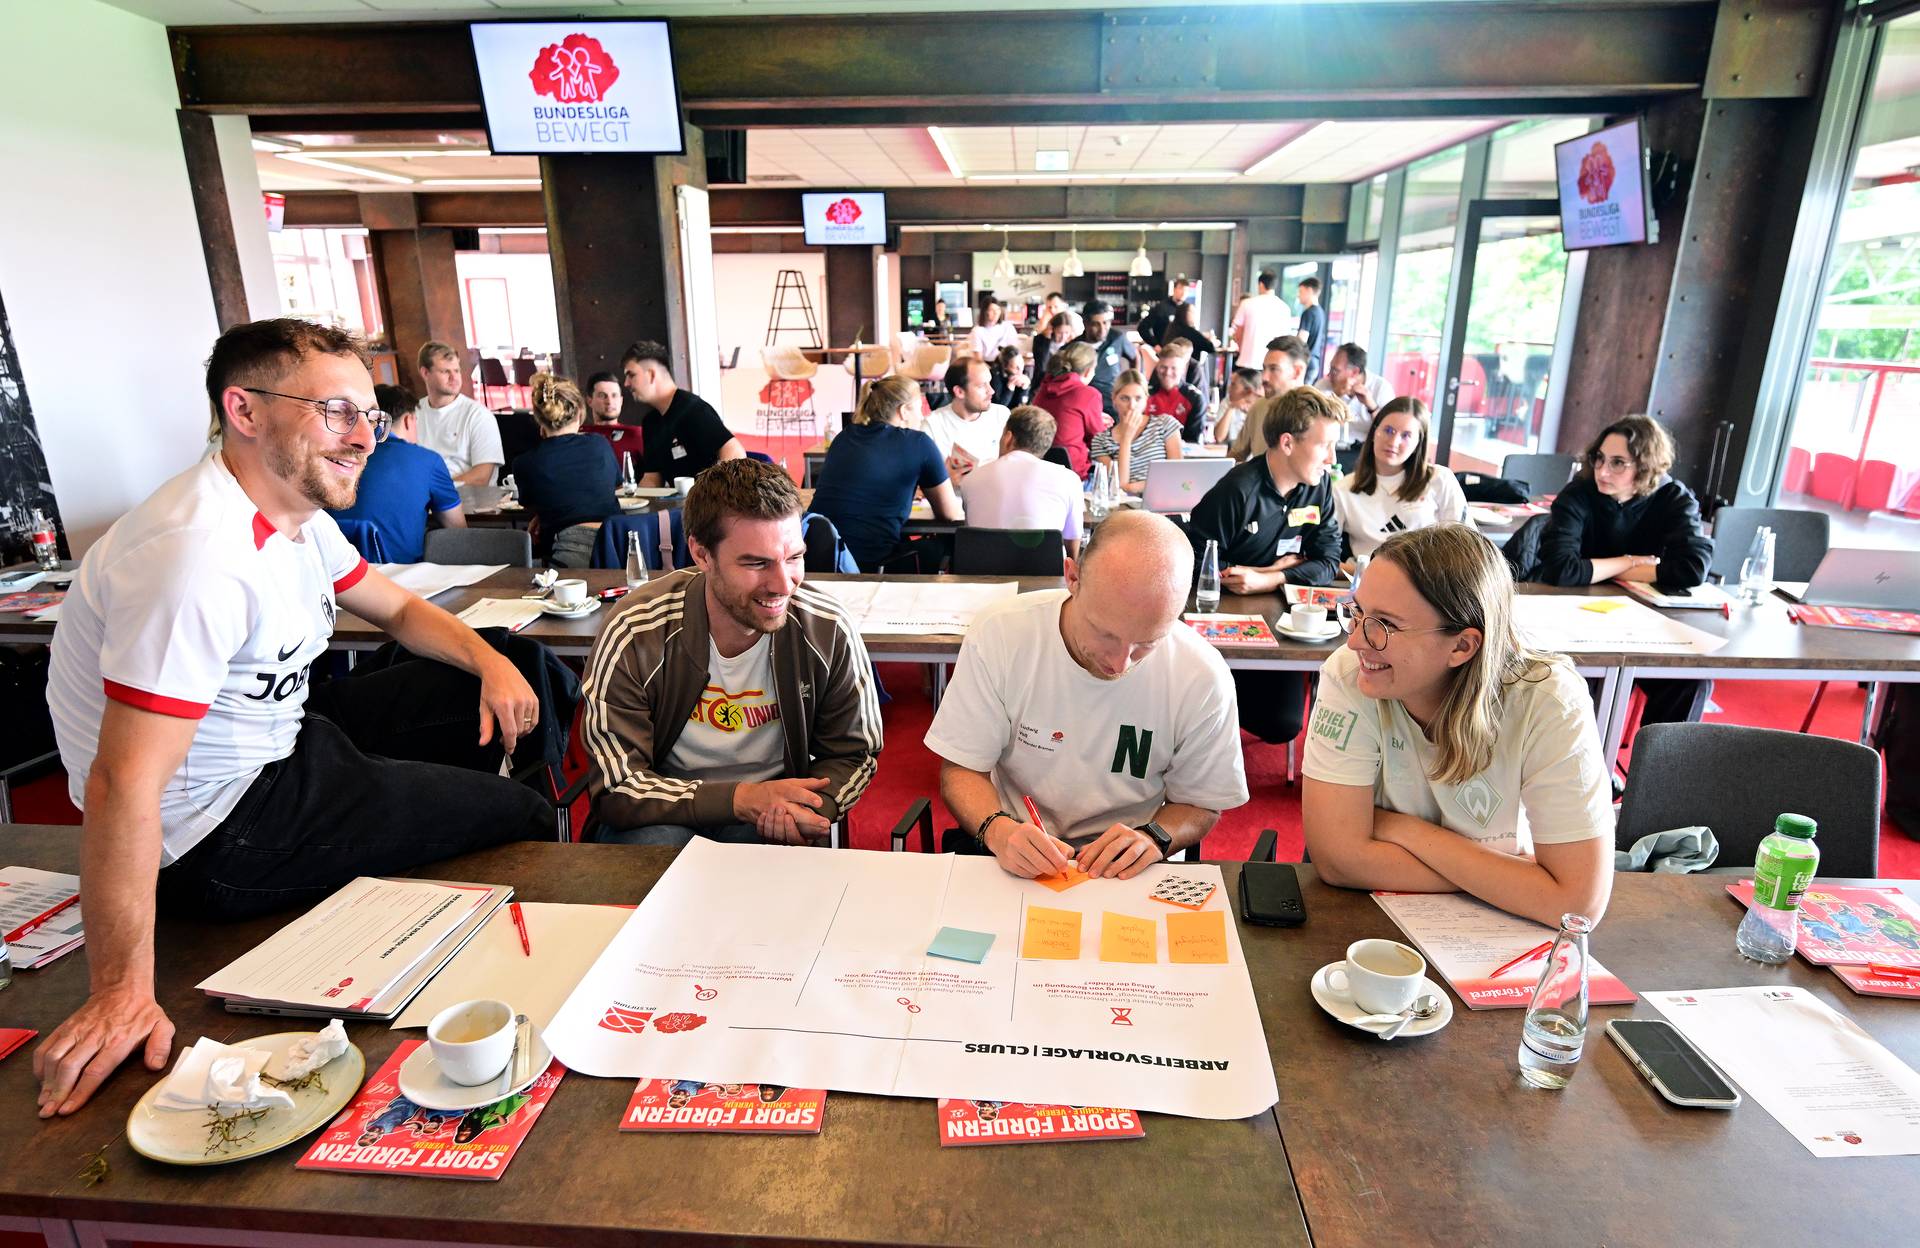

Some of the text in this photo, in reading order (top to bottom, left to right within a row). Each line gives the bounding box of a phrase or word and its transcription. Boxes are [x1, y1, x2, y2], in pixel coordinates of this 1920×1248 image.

[533, 106, 630, 119] BUNDESLIGA
[536, 121, 630, 142] BEWEGT
[1317, 708, 1346, 728] SPIEL
[1020, 723, 1039, 734] Ludwig
[1314, 721, 1342, 741] RAUM
[1111, 725, 1153, 779] N
[1064, 994, 1108, 1002] Umsetzung
[1469, 986, 1524, 1000] Försterei
[965, 1043, 1030, 1057] CLUBS
[1041, 1047, 1230, 1072] ARBEITSVORLAGE
[723, 1101, 755, 1109] VEREIN
[798, 1101, 818, 1109] KITA
[1073, 1107, 1105, 1115] SCHULE
[629, 1106, 816, 1127] SPORT FÖRDERN
[1036, 1109, 1067, 1117] VEREIN
[946, 1112, 1135, 1138] SPORT FÖRDERN
[412, 1141, 510, 1153] KITA SCHULE VEREIN
[309, 1141, 505, 1170] SPORT FÖRDERN
